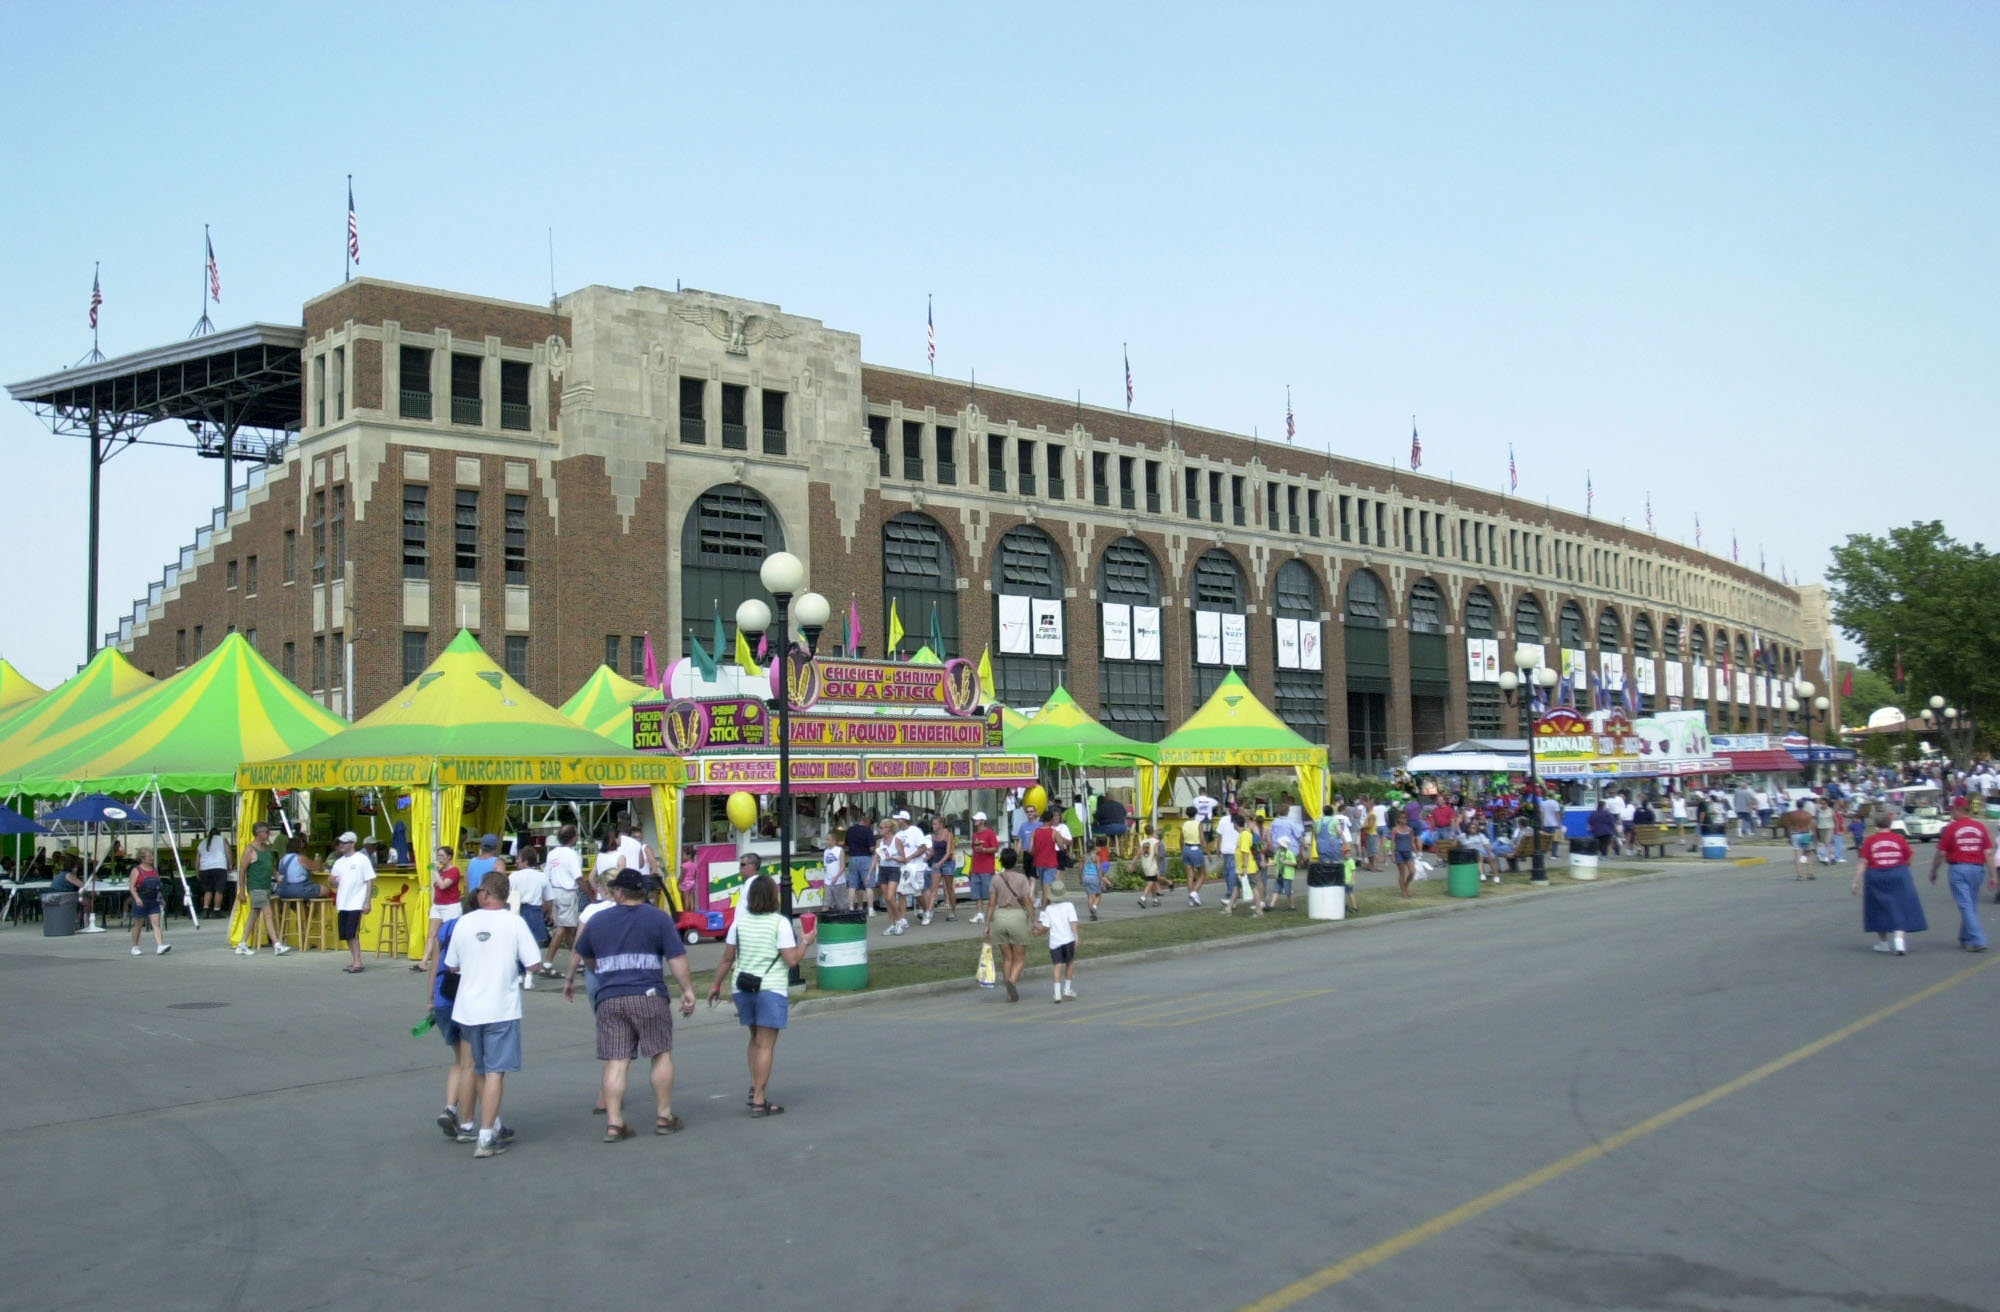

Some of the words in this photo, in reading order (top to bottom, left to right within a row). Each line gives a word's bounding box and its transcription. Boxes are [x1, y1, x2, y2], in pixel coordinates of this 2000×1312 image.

[823, 667, 884, 683] CHICKEN
[894, 670, 942, 685] SHRIMP
[824, 682, 857, 698] ON
[860, 684, 878, 698] A
[882, 684, 937, 700] STICK
[634, 711, 663, 722] CHICKEN
[711, 705, 737, 716] SHRIMP
[640, 721, 651, 732] ON
[651, 721, 659, 732] A
[715, 716, 726, 726] ON
[726, 716, 734, 726] A
[635, 732, 663, 748] STICK
[710, 726, 739, 742] STICK
[846, 723, 897, 743] POUND
[900, 724, 981, 744] TENDERLOIN
[1535, 736, 1593, 753] LEMONADE
[1159, 751, 1205, 764] ARGARITA
[1209, 751, 1226, 764] BAR
[1242, 752, 1277, 764] COLD
[1281, 752, 1311, 764] BEER
[250, 762, 302, 785] MARGARITA
[307, 762, 326, 784] BAR
[343, 764, 379, 783] COLD
[382, 763, 416, 782] BEER
[456, 759, 534, 781] MARGARITA
[540, 760, 562, 780] BAR
[585, 763, 626, 782] COLD
[632, 763, 667, 781] BEER
[711, 761, 777, 771] CHEESE
[790, 762, 825, 778] ONION
[827, 762, 857, 778] RINGS
[868, 761, 905, 777] CHICKEN
[711, 770, 729, 780] ON
